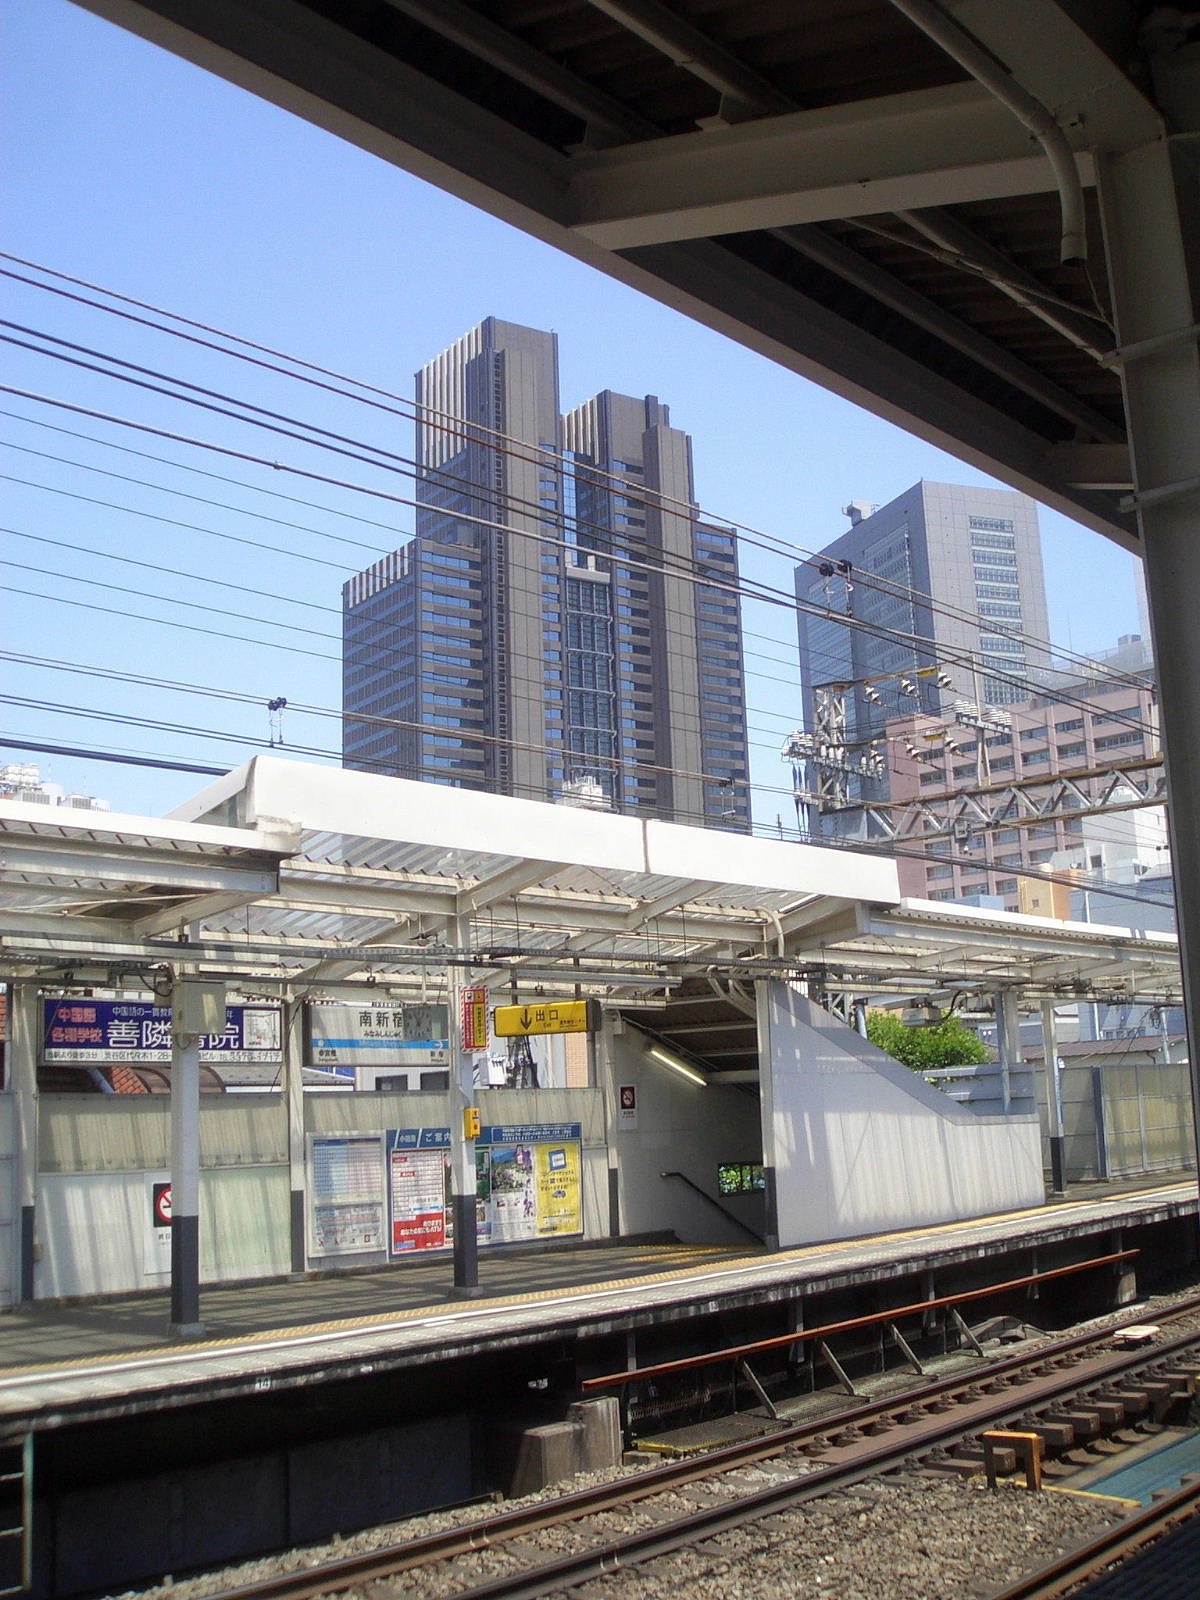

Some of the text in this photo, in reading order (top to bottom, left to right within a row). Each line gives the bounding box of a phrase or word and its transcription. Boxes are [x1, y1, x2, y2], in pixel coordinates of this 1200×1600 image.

[535, 1009, 559, 1022] 出口
[107, 1019, 239, 1049] 善隣院
